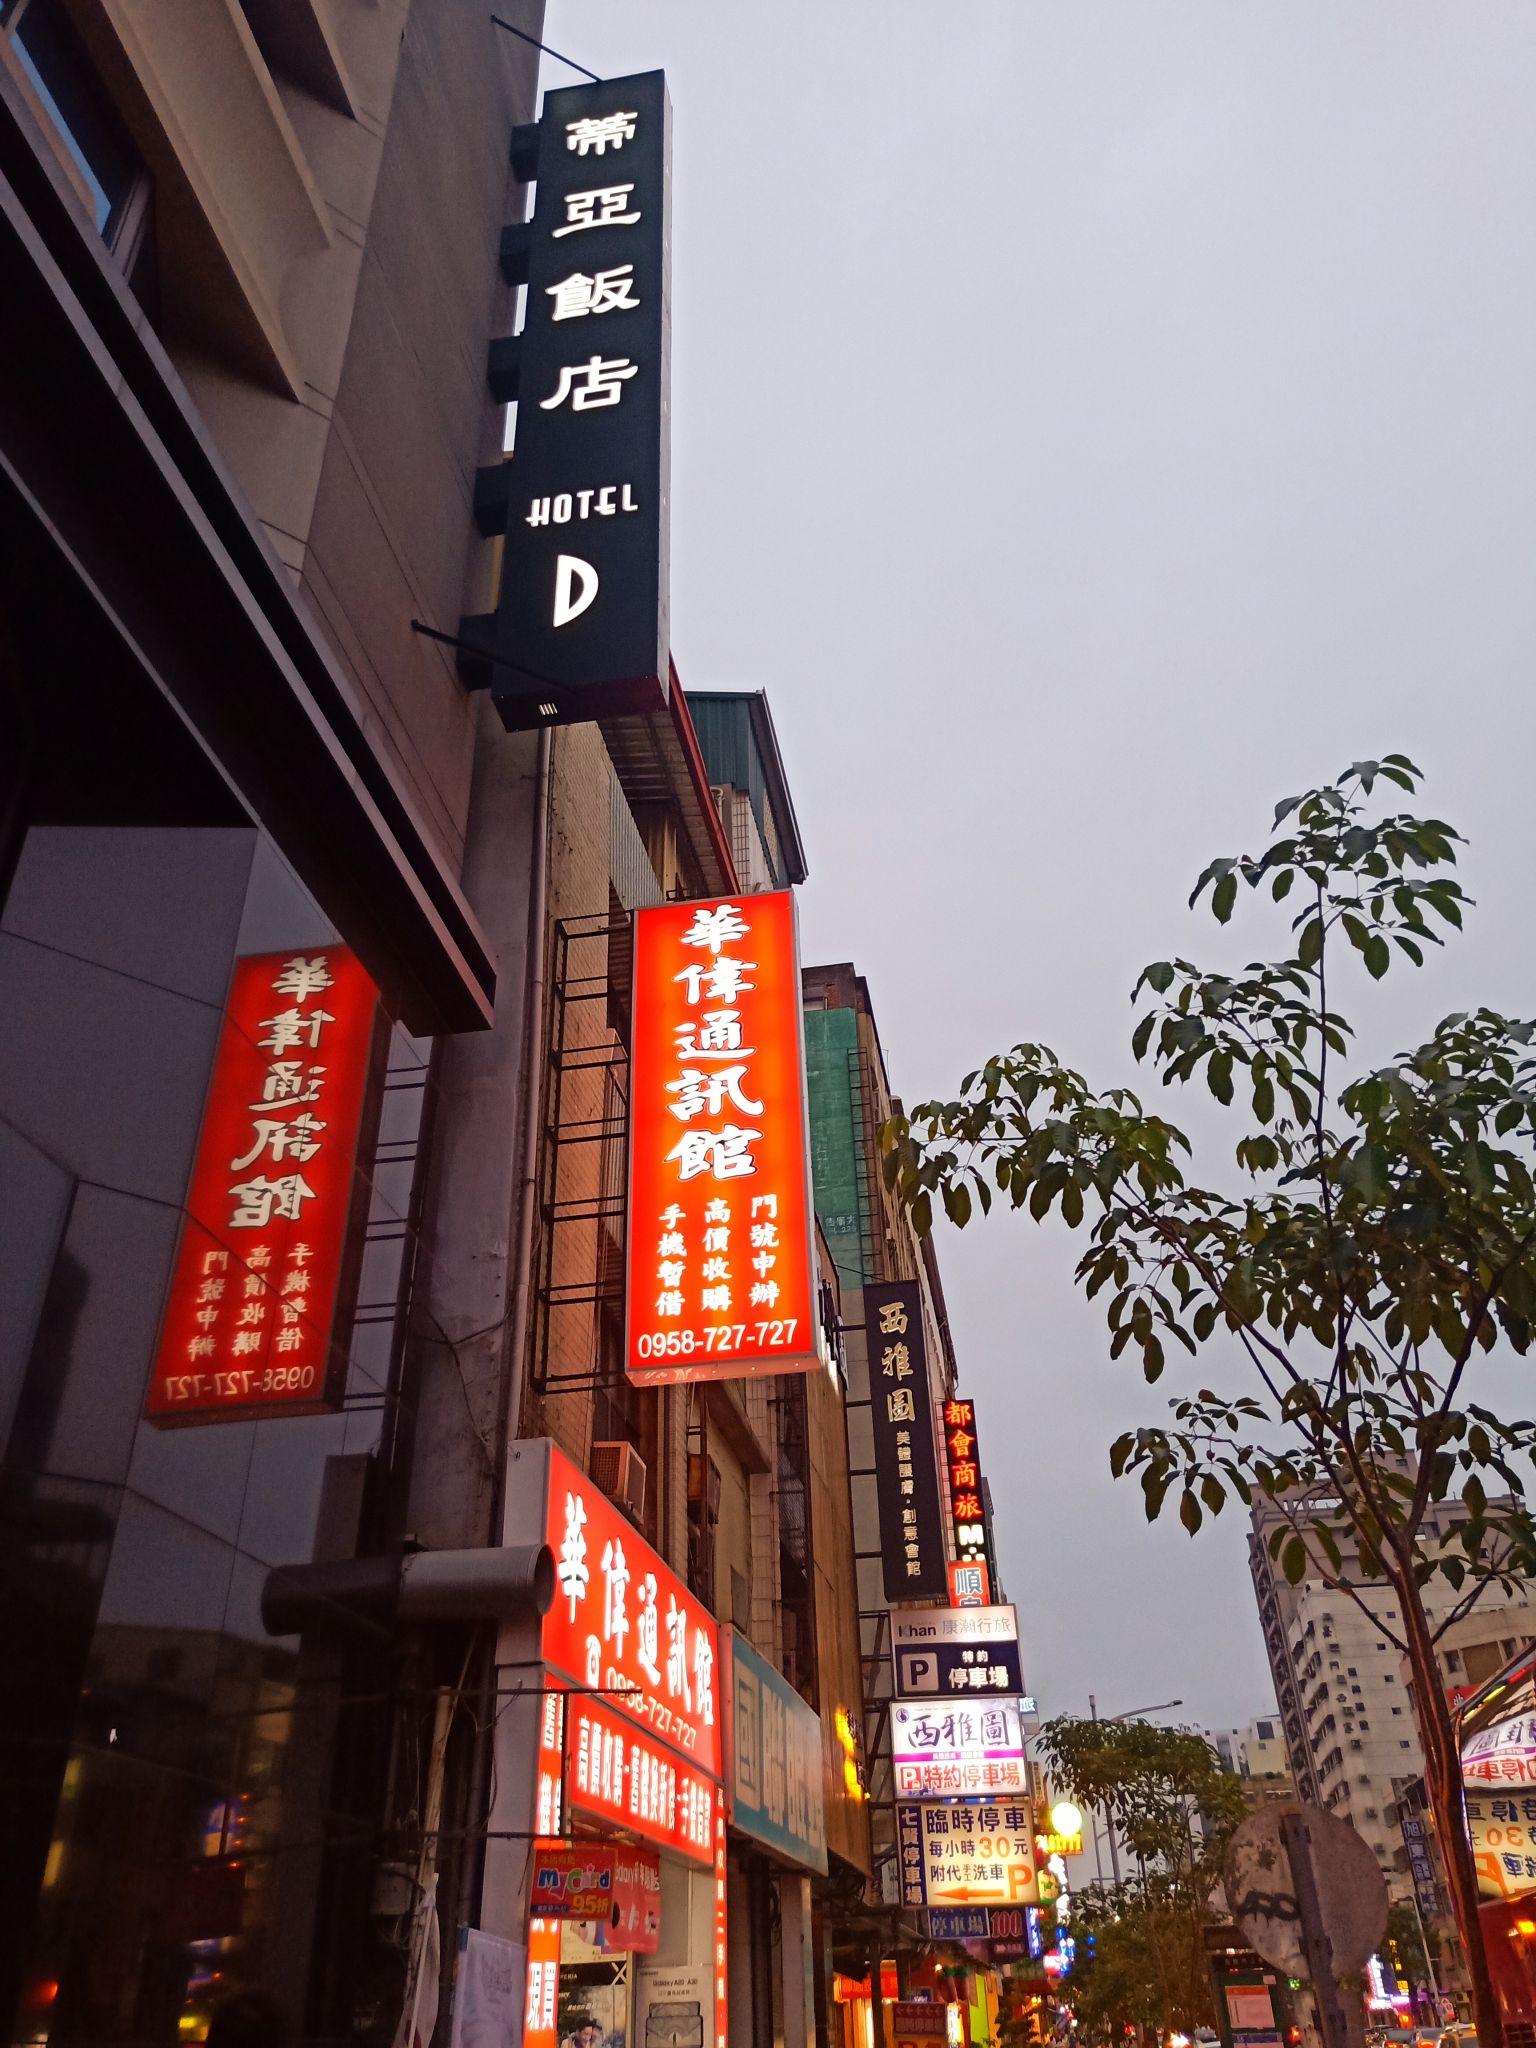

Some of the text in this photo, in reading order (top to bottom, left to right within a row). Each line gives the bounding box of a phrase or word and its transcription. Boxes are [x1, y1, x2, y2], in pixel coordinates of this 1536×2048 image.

[539, 111, 642, 412] 蒂亞飯店
[525, 483, 639, 527] HOTEL
[553, 554, 599, 628] D
[663, 903, 765, 1182] 華偉通訊館
[655, 1203, 687, 1317] 手機暫借
[701, 1197, 733, 1312] 高價收購
[749, 1193, 781, 1309] 門號申辦
[638, 1318, 799, 1358] 0958-727-727
[878, 1301, 917, 1423] 西雅圖
[945, 1401, 983, 1519] 都會商旅
[557, 1490, 715, 1727] 華偉通訊館
[910, 1659, 1010, 1689] P 停車場
[606, 1666, 697, 1750] 0958-727-727
[907, 1709, 1012, 1748] 西雅圖
[924, 1761, 1020, 1790] 特約停車場
[926, 1805, 1028, 1834] 臨時停車
[928, 1836, 1029, 1859] 每小時30元
[536, 1862, 611, 1900] MyCard
[572, 1893, 609, 1913] 95折
[1008, 1863, 1033, 1900] P
[991, 1910, 1022, 1938] 100
